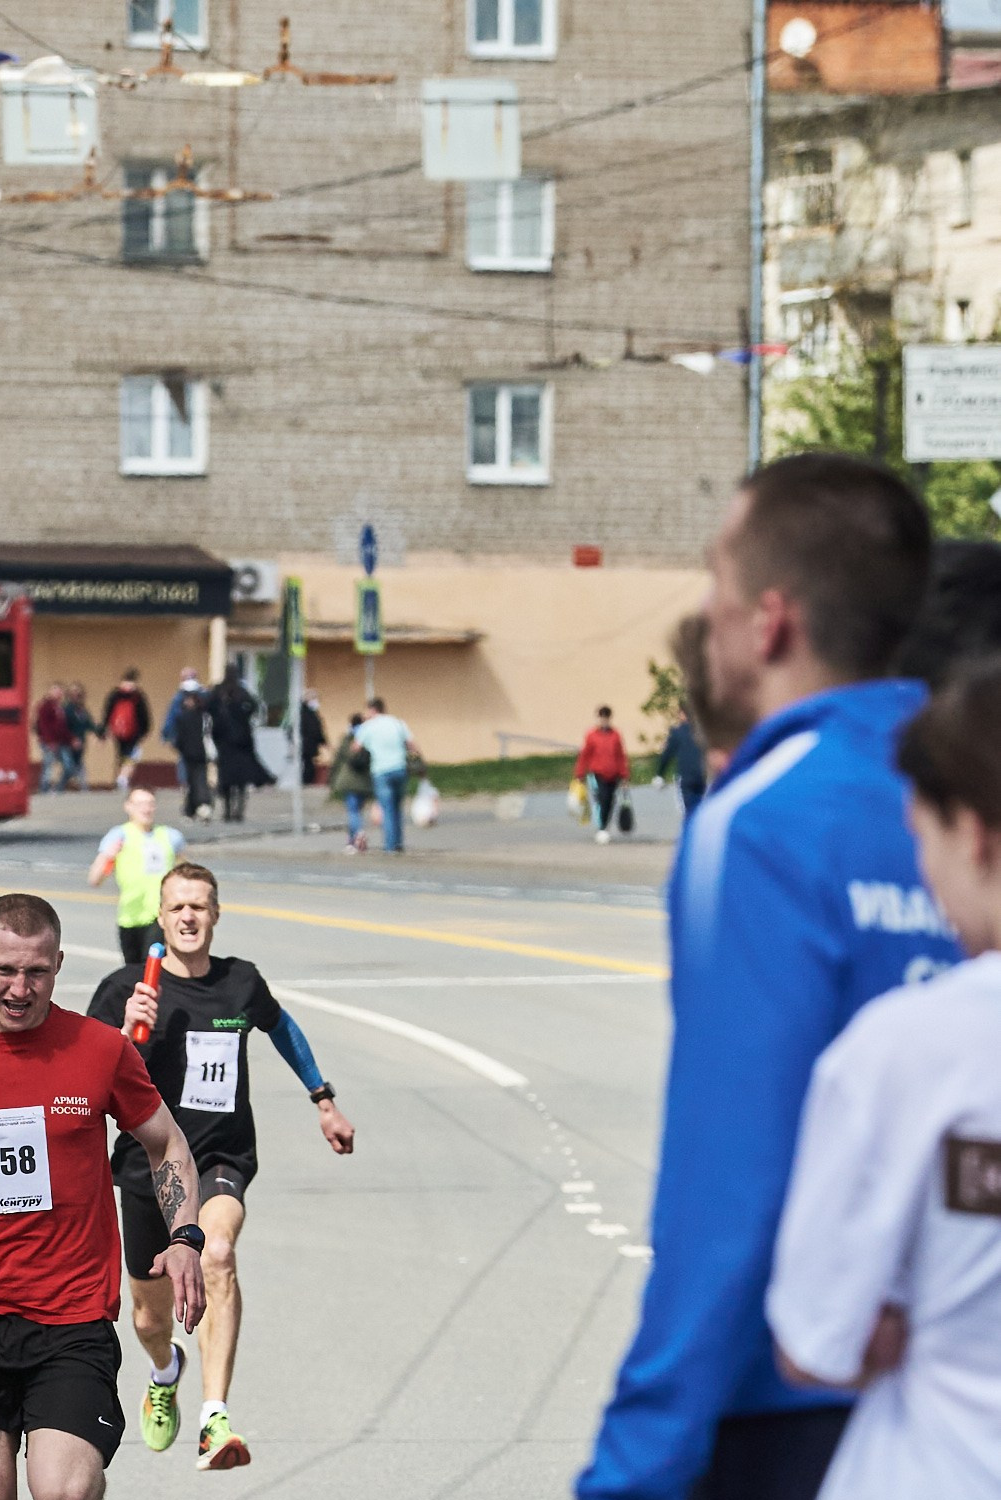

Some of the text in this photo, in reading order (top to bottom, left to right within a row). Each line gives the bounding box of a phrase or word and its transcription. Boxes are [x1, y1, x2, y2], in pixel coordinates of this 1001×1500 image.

[201, 1062, 225, 1081] 111
[53, 1096, 88, 1106] АРМИЯ
[50, 1106, 91, 1116] РОССИИ
